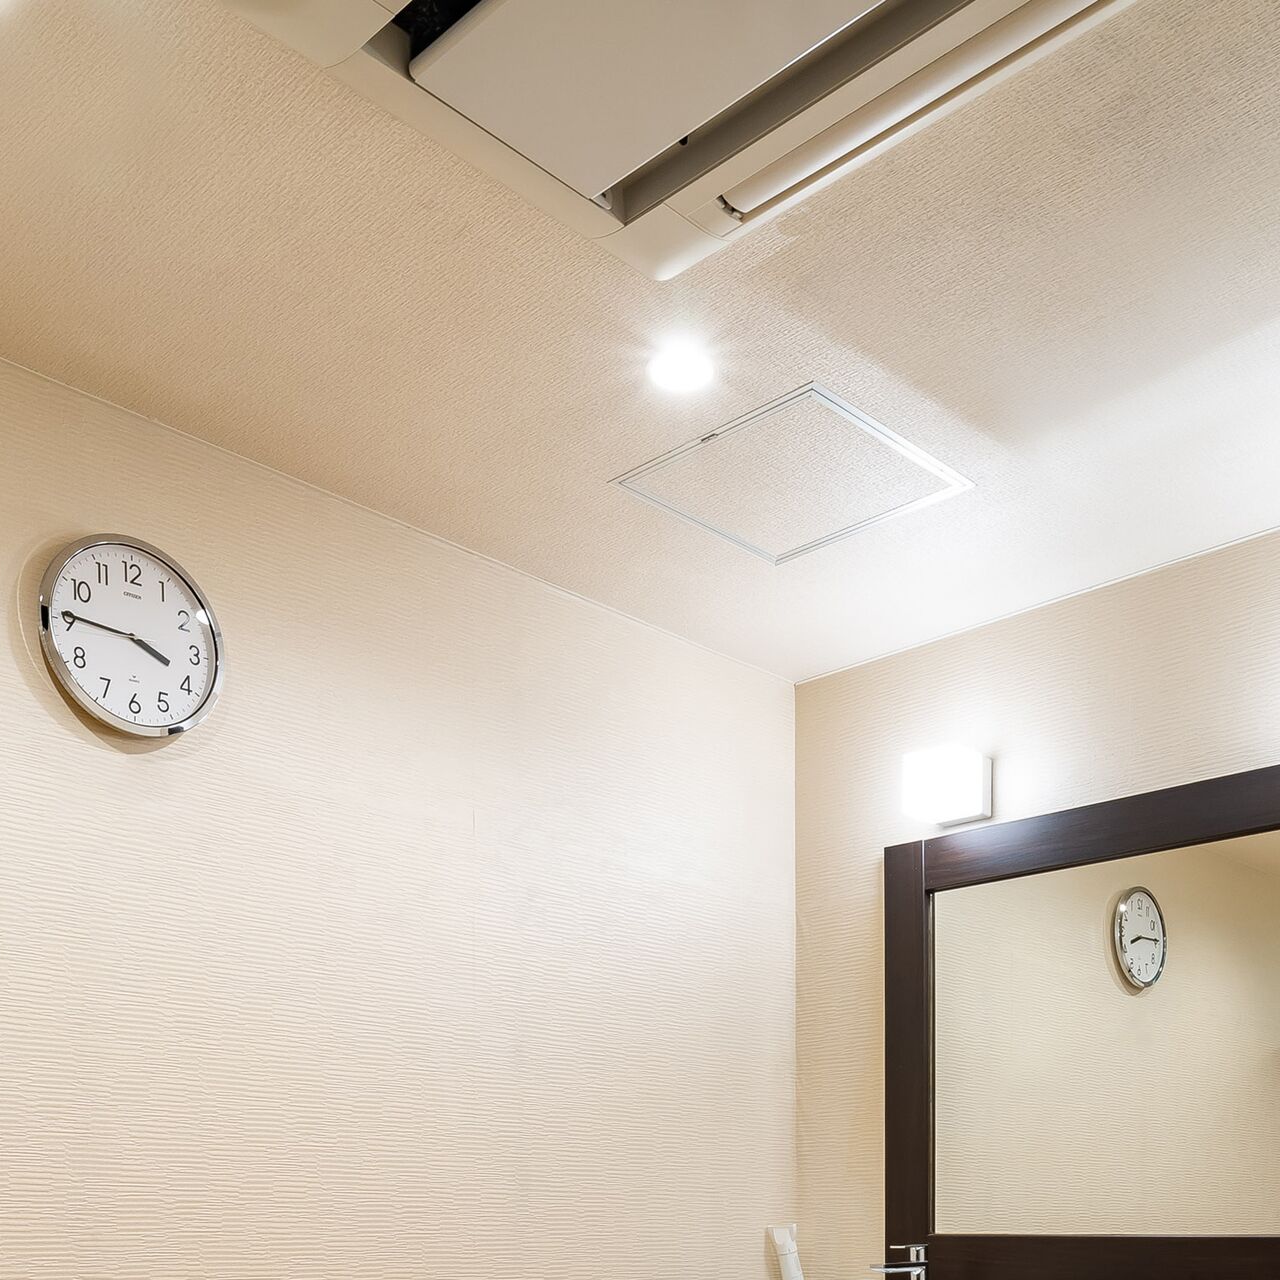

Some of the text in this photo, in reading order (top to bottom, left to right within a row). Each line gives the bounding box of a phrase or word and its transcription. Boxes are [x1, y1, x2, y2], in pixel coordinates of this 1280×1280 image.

[95, 562, 109, 586] 11
[122, 560, 142, 587] 12
[71, 578, 92, 603] 10
[158, 581, 165, 602] 1
[177, 610, 191, 632] 2
[73, 646, 87, 669] 8
[189, 645, 201, 666] 3
[99, 676, 112, 699] 7
[180, 675, 193, 696] 4
[128, 693, 142, 714] 6
[157, 692, 170, 713] 5
